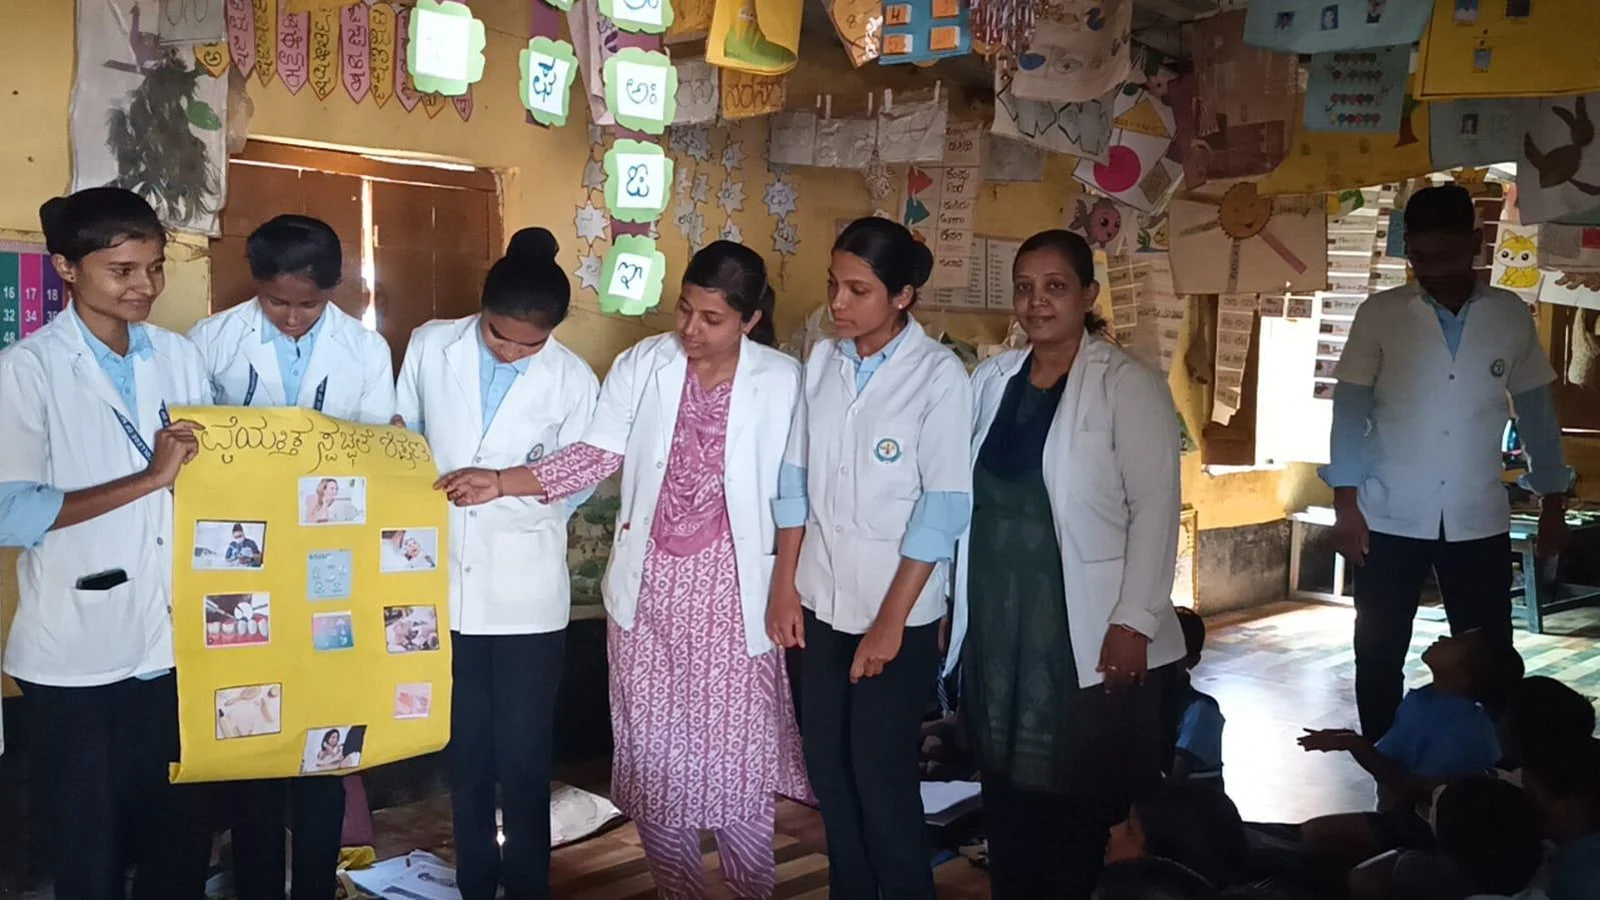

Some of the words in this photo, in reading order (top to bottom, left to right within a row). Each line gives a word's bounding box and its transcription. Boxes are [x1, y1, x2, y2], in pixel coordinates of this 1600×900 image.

[3, 286, 15, 299] 16
[25, 287, 37, 300] 17
[47, 288, 58, 301] 18
[3, 309, 15, 322] 32
[25, 310, 37, 323] 34
[3, 331, 16, 344] 48
